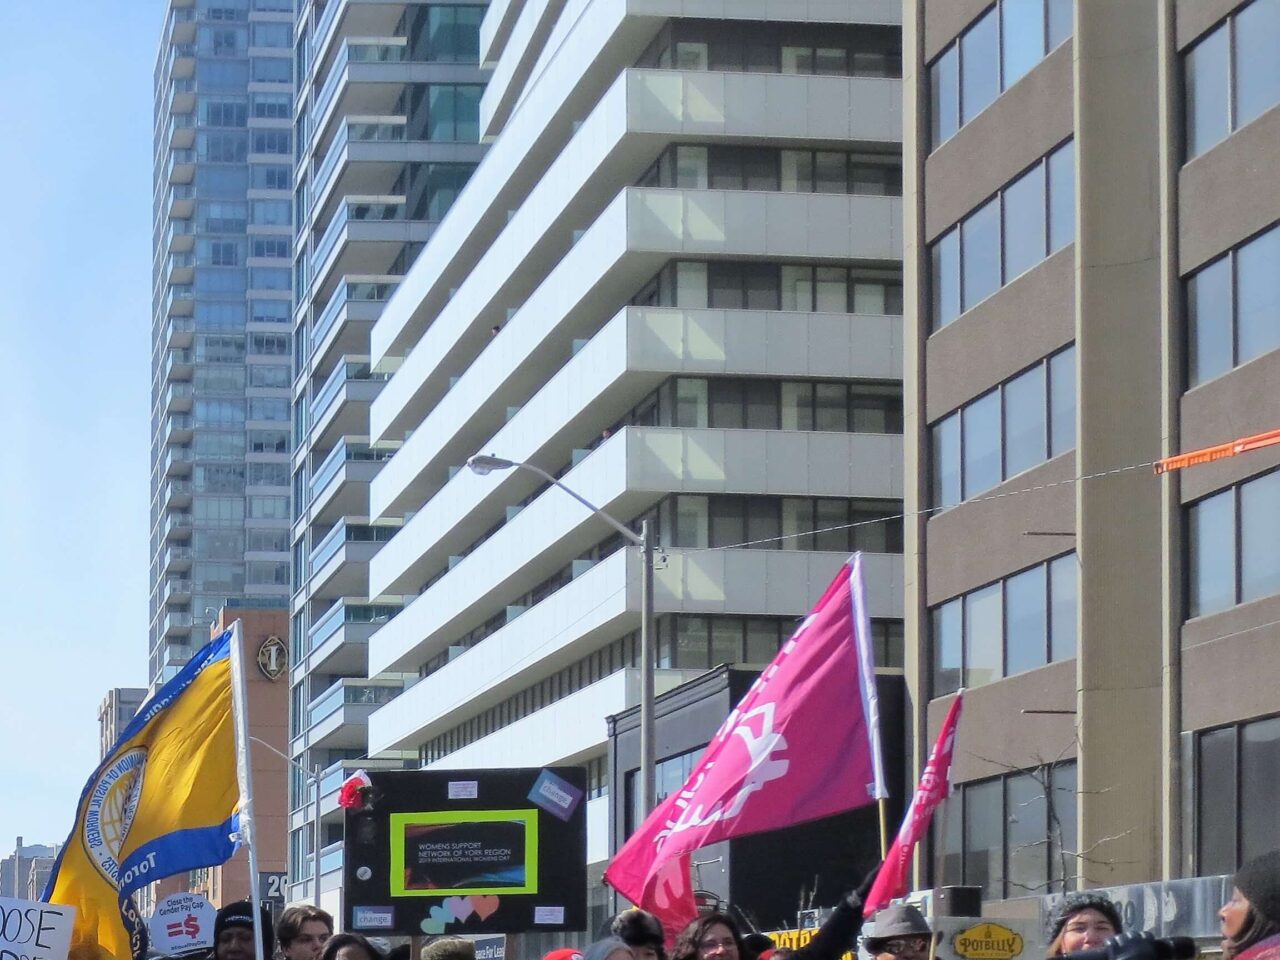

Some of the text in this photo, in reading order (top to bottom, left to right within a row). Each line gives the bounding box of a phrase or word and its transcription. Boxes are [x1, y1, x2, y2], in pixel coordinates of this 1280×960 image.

[451, 841, 481, 849] SUPPORT
[418, 850, 451, 858] NETWORK
[453, 849, 462, 857] OF
[484, 848, 511, 856] REGION
[166, 895, 194, 907] Close the
[159, 900, 205, 917] Gender Pay Gap
[958, 936, 1017, 953] POTBELLY
